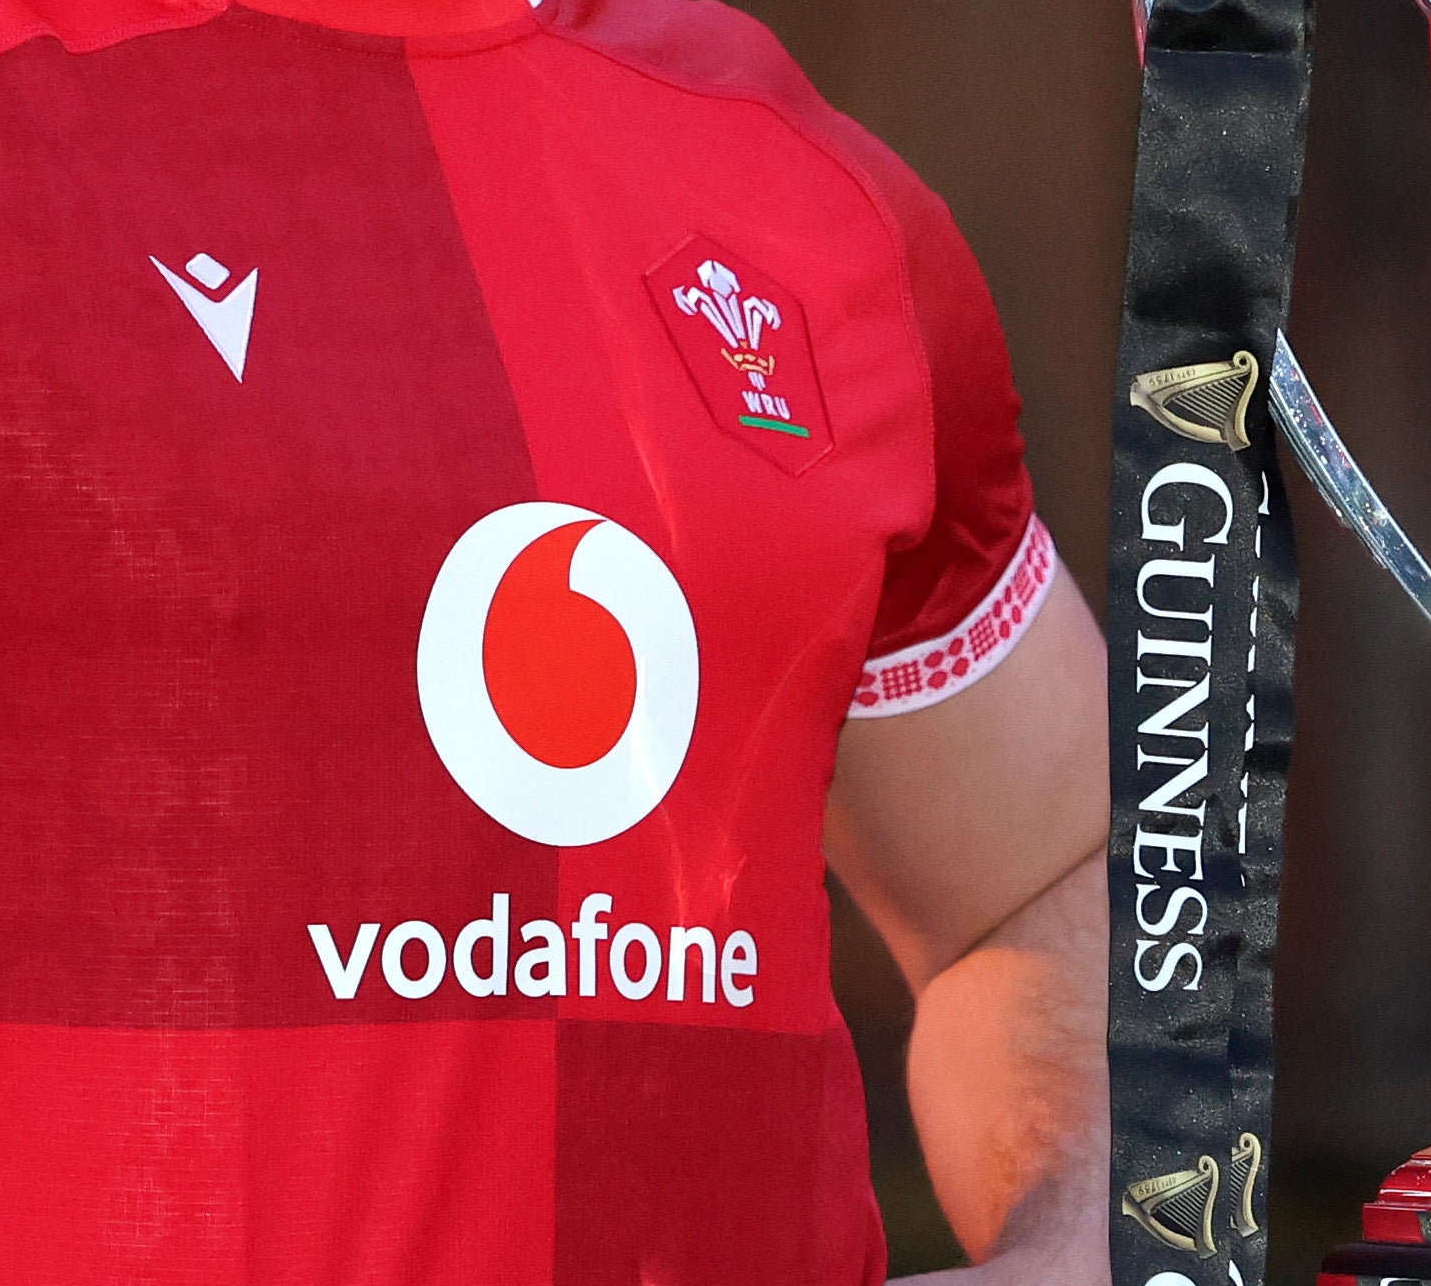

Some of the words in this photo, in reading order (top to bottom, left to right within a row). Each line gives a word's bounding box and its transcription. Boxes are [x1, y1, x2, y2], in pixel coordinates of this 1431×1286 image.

[741, 390, 791, 420] WRU
[1132, 462, 1233, 992] GUINNESS
[307, 893, 759, 1007] vodafone
